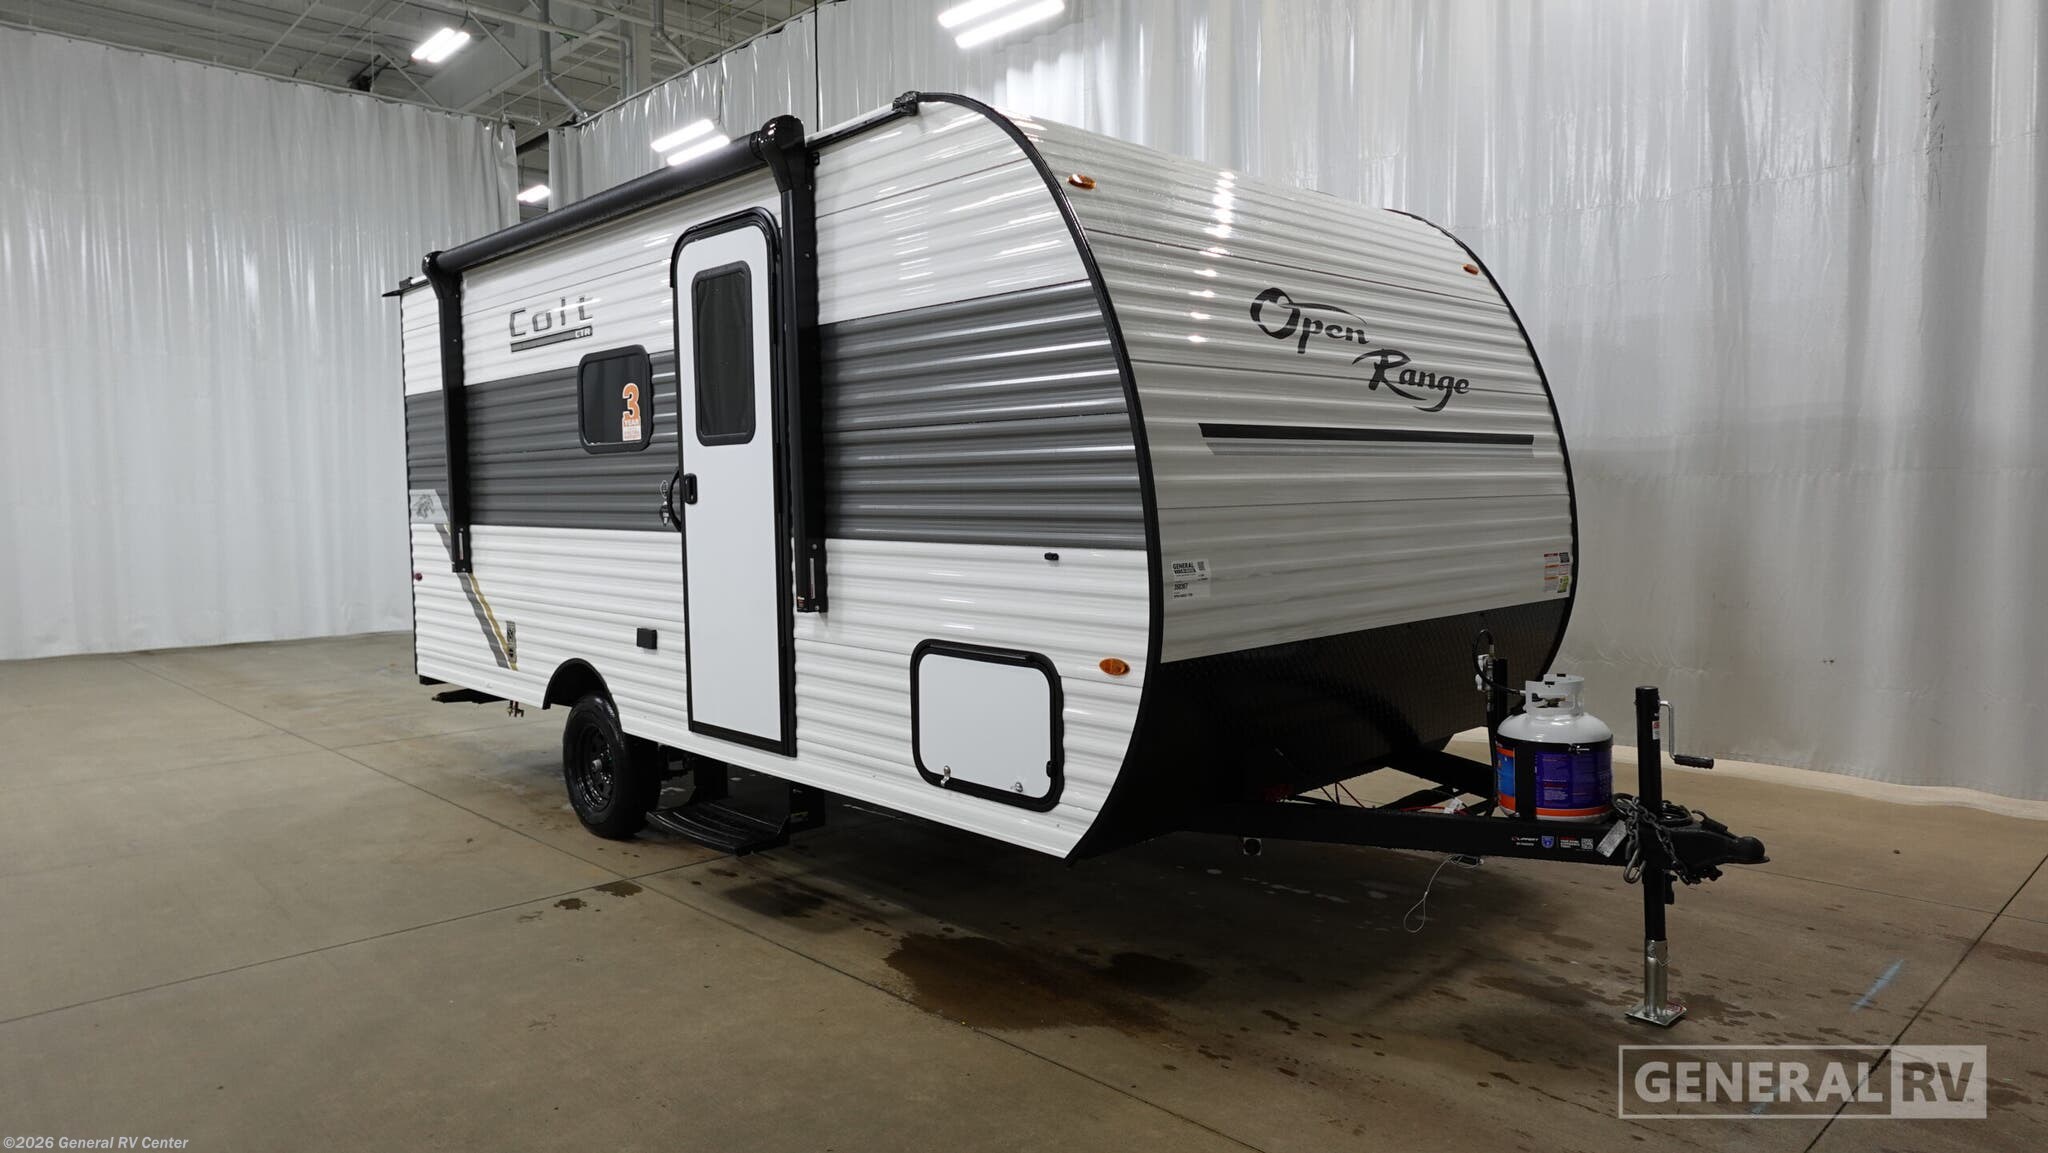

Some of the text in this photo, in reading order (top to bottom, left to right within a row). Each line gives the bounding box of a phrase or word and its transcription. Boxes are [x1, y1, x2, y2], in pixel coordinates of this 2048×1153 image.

[509, 297, 593, 337] Colt
[575, 328, 591, 338] CTR
[1250, 287, 1369, 354] Open
[1352, 349, 1470, 412] Range
[622, 383, 641, 420] 3
